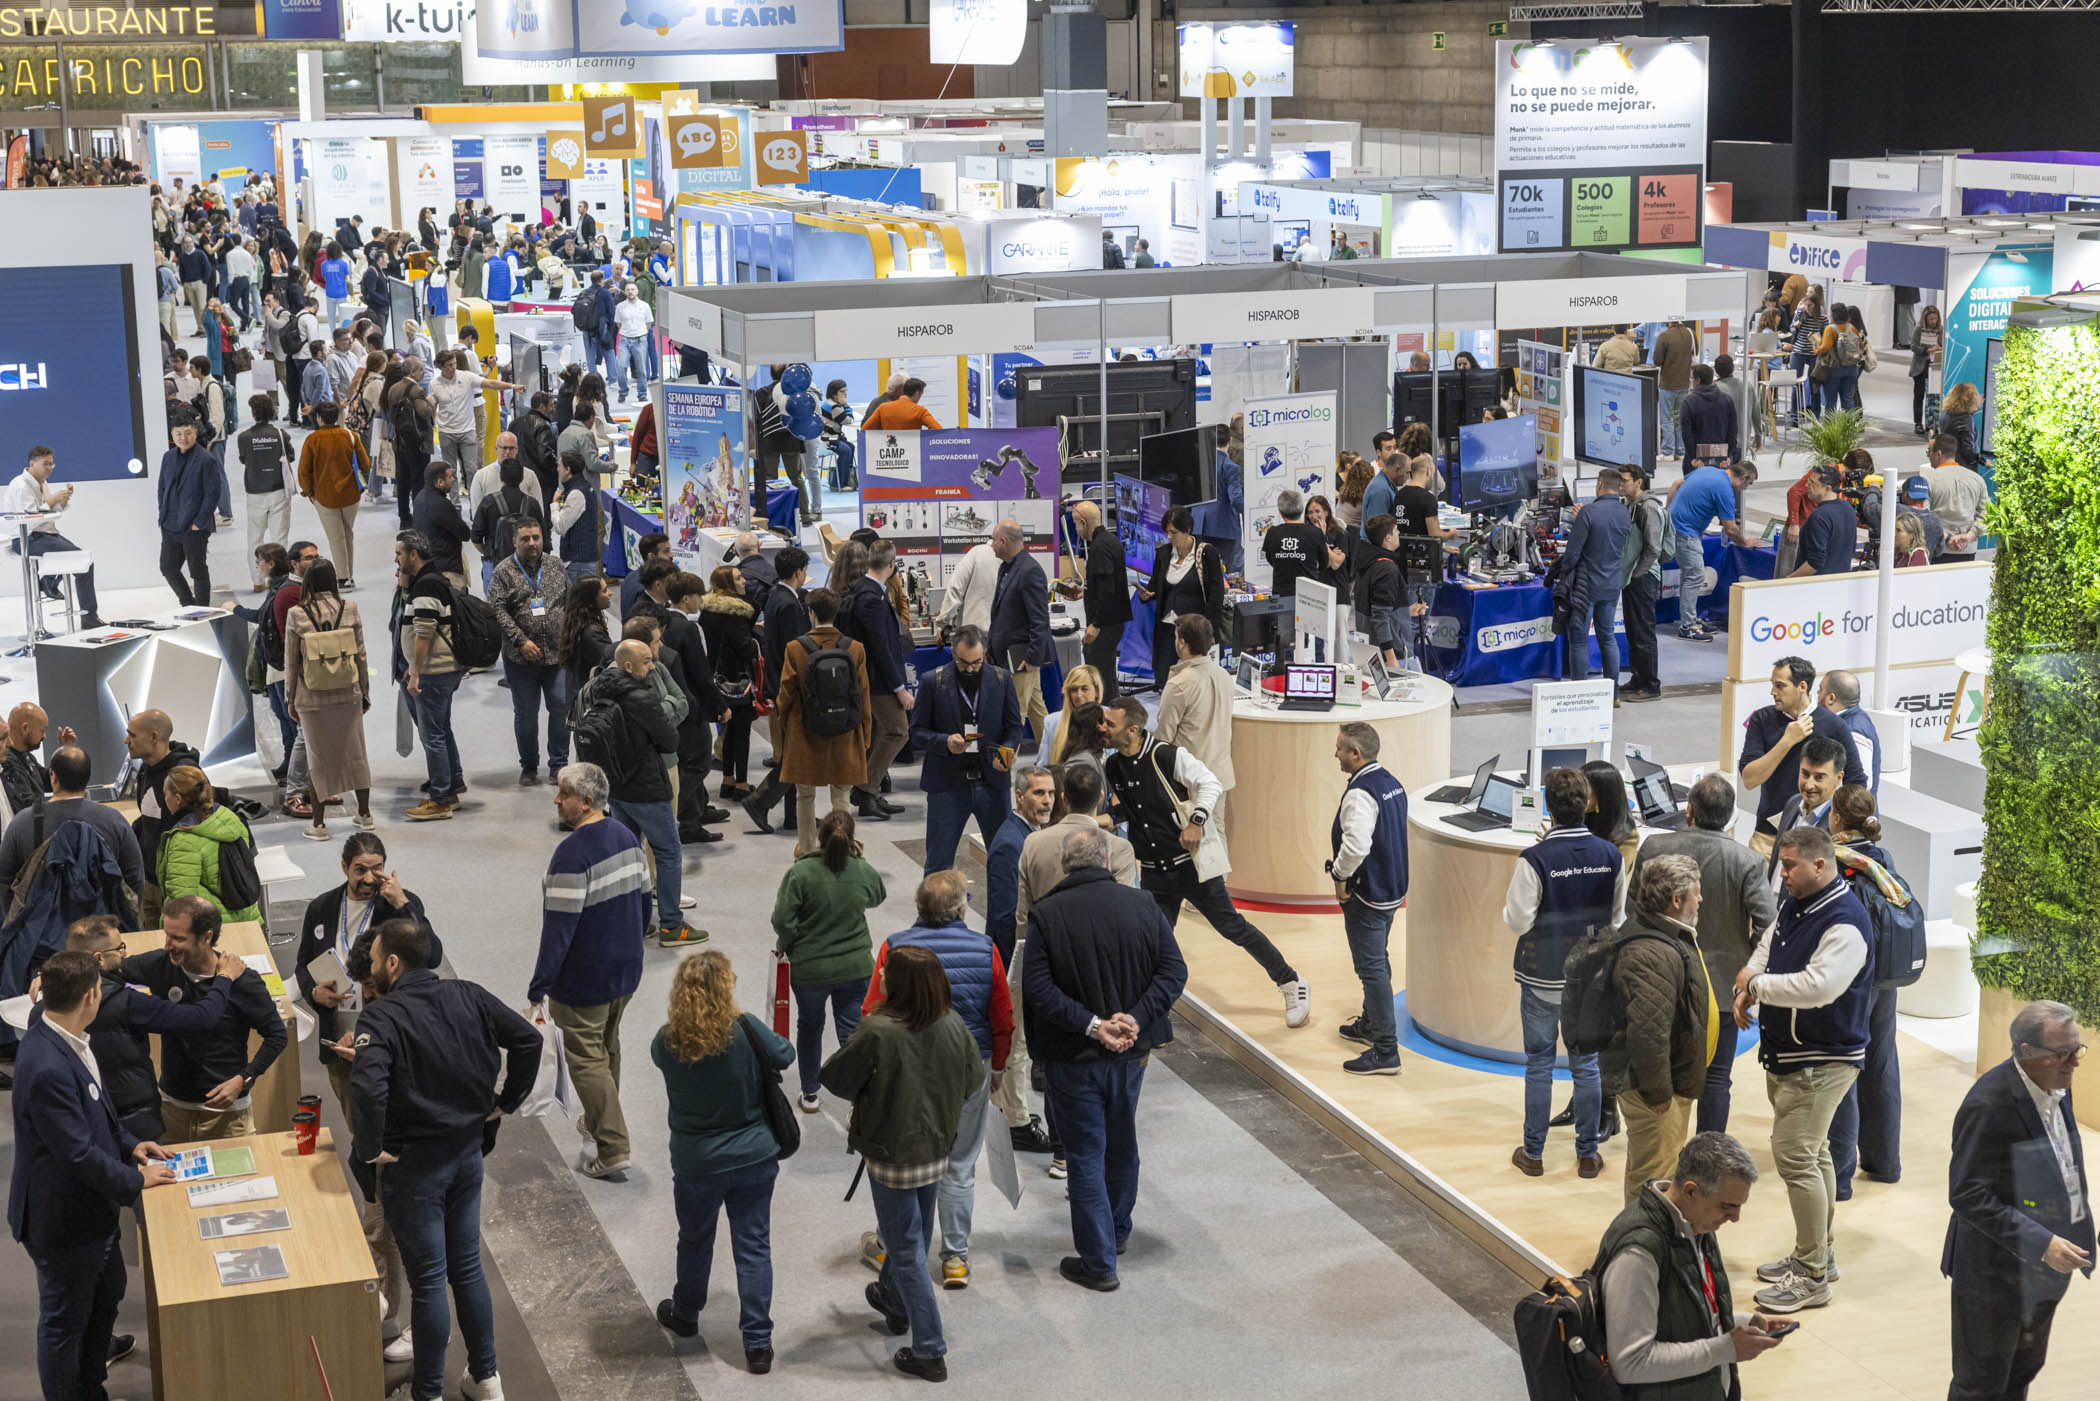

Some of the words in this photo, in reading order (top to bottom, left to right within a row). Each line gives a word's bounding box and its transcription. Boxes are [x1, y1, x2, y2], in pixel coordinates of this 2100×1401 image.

[0, 8, 216, 36] STAURANTE
[706, 5, 796, 27] LEARN
[576, 57, 636, 69] Learning
[0, 57, 204, 96] APRICHO
[1510, 84, 1527, 97] Lo
[1531, 85, 1557, 99] que
[1560, 85, 1577, 96] no
[1581, 86, 1597, 97] se
[1600, 82, 1639, 97] mide,
[1510, 102, 1527, 113] no
[1531, 102, 1547, 113] se
[1550, 98, 1593, 115] puede
[1597, 100, 1656, 114] mejorar.
[681, 130, 713, 144] ABC
[768, 146, 797, 161] 123
[688, 167, 742, 184] DIGITAL
[1509, 185, 1543, 202] 70k
[1577, 183, 1613, 200] 500
[1644, 181, 1667, 198] 4k
[1262, 190, 1280, 212] tellfy
[1576, 204, 1602, 212] Colegios
[1337, 198, 1359, 221] tellfy
[1970, 286, 2031, 300] SOLUCIONES
[1569, 296, 1618, 308] HISPAROB
[1248, 309, 1300, 322] HISPAROB
[897, 323, 954, 338] HISPAROB
[1969, 319, 2008, 331] INTERAC
[668, 393, 694, 404] SEMANA
[694, 395, 722, 406] EUROPEA
[669, 404, 676, 414] DE
[678, 405, 685, 415] LA
[1273, 405, 1331, 423] microlog
[879, 448, 905, 459] CAMP
[935, 488, 961, 496] FRANKA
[1275, 550, 1306, 561] microlog
[1751, 611, 1835, 645] Google
[1842, 610, 1873, 634] for
[1889, 599, 1984, 630] ducation
[1895, 692, 1956, 712] ASUS
[1551, 867, 1573, 878] Google
[1574, 866, 1582, 875] for
[1584, 864, 1612, 874] Education
